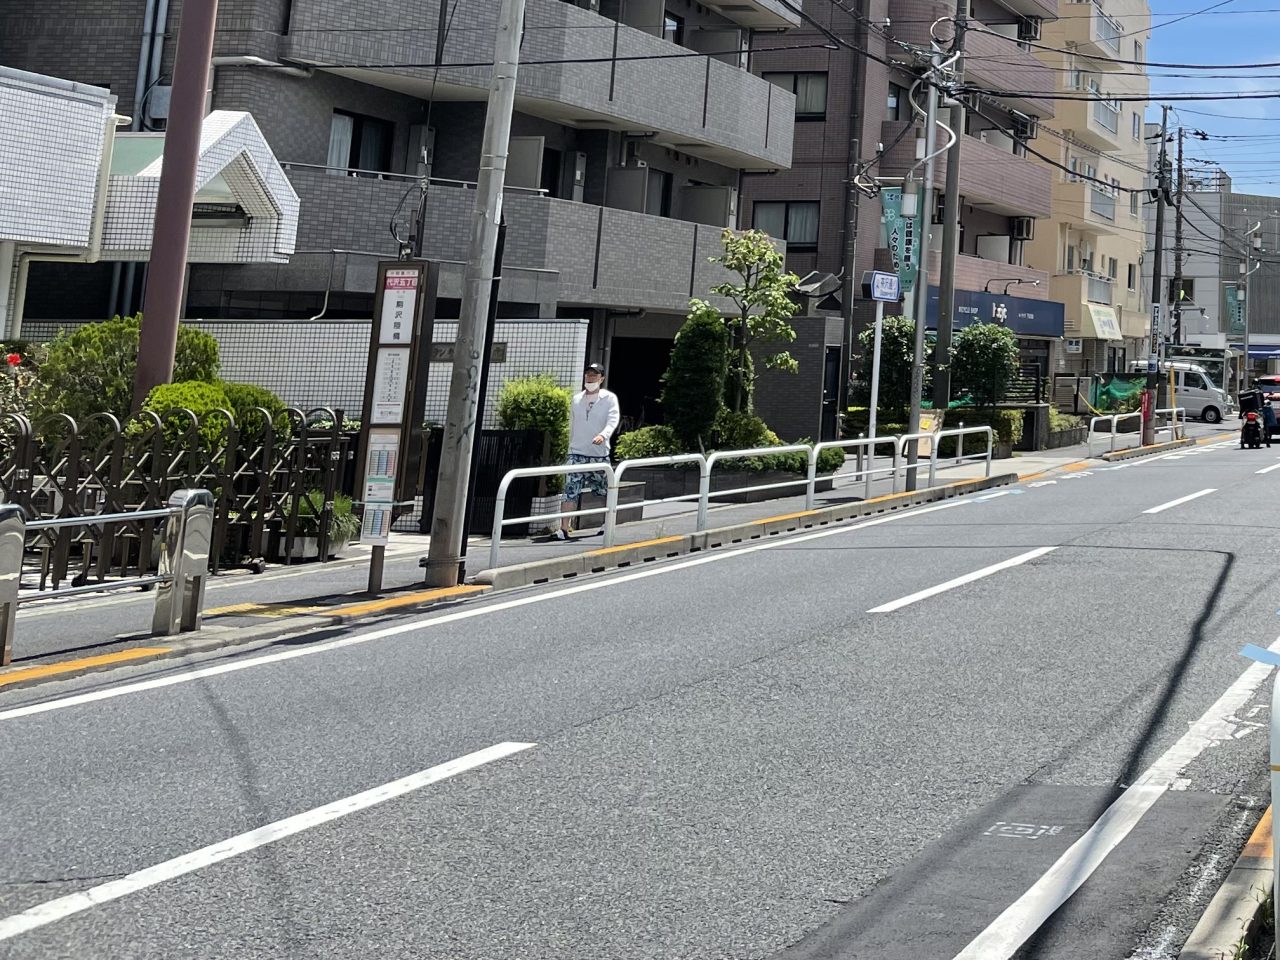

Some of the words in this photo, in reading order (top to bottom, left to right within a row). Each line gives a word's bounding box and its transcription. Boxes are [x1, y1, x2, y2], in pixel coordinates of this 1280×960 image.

[904, 217, 913, 271] は健康を願う
